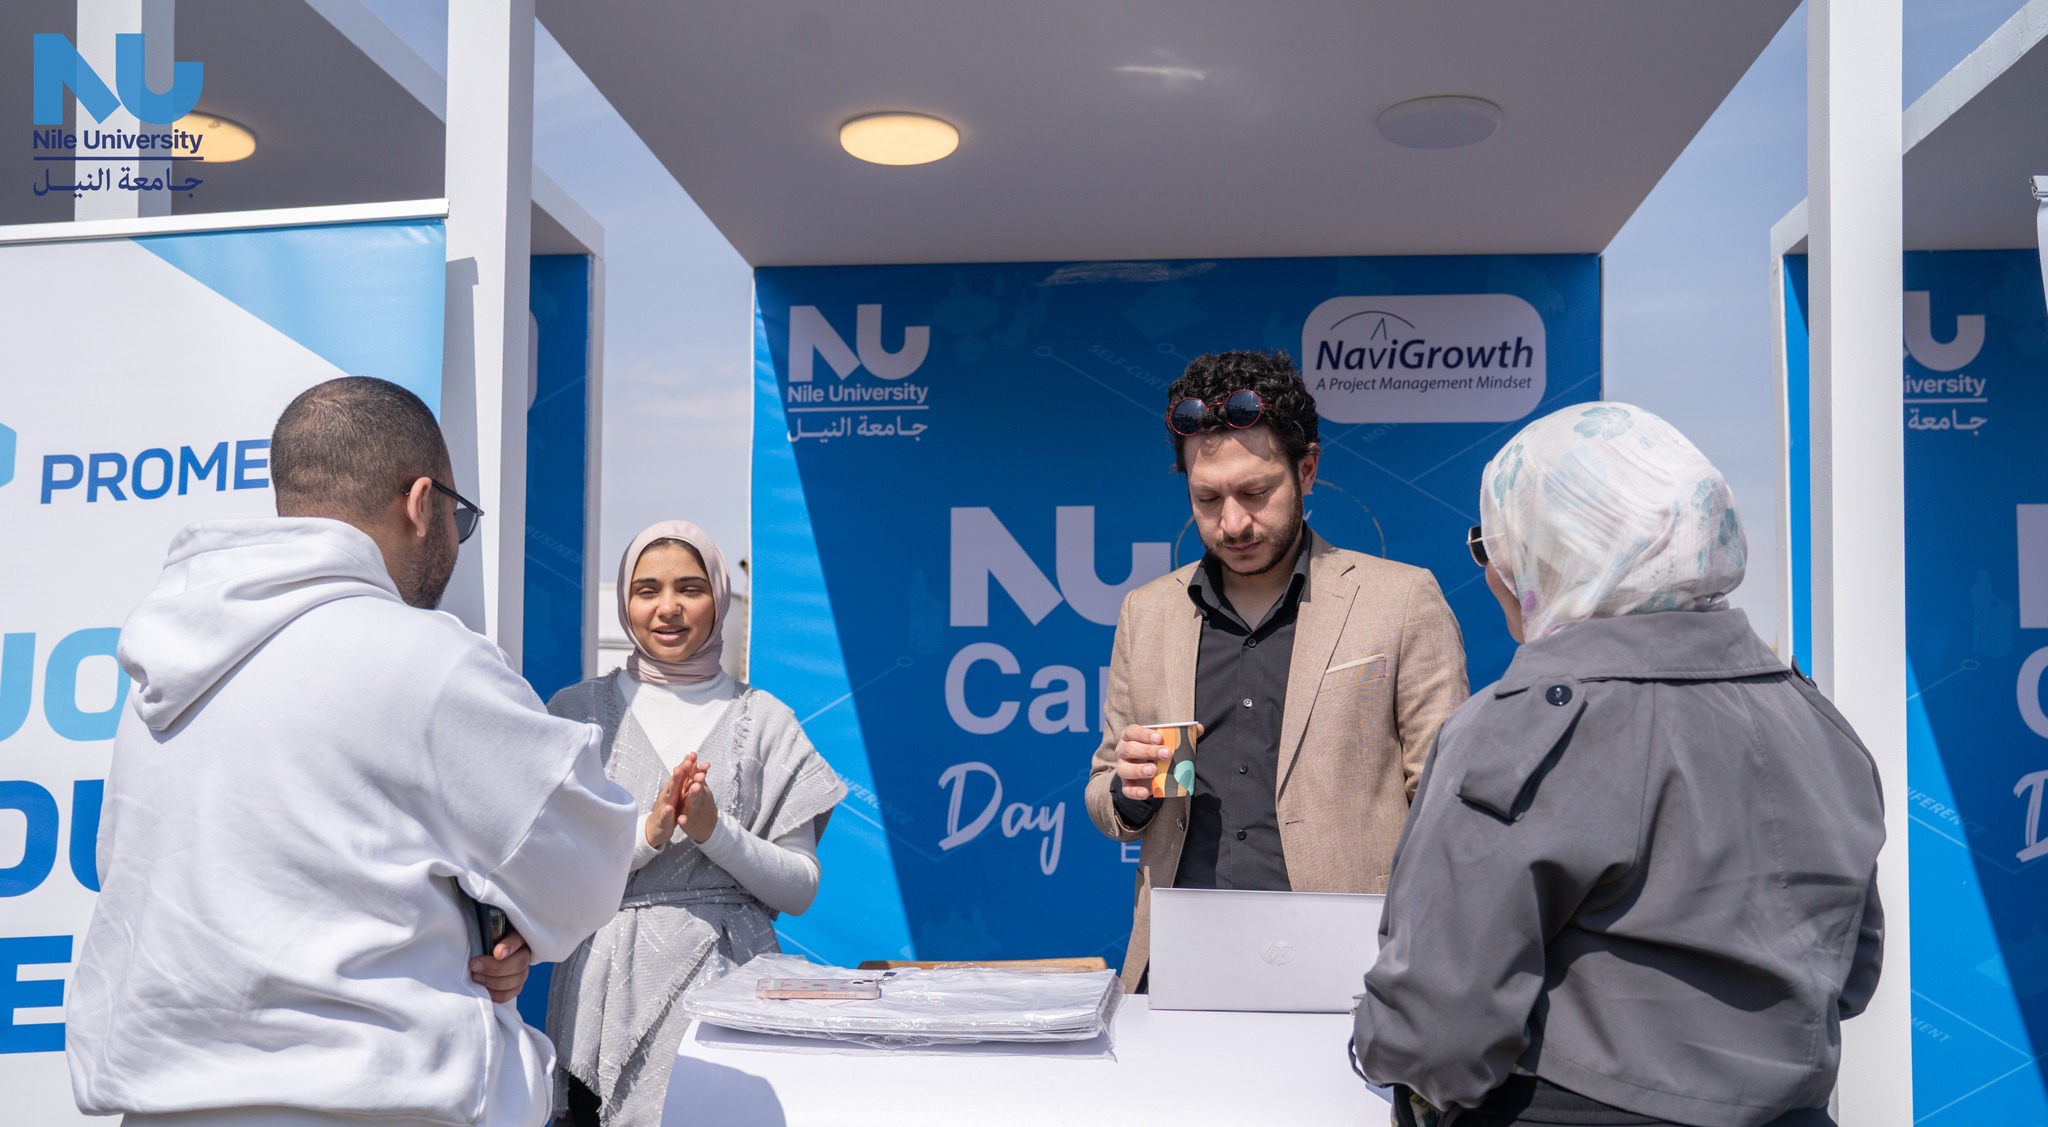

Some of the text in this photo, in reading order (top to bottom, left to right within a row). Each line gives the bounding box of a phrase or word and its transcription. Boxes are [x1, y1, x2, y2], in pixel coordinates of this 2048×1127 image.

[788, 303, 931, 382] NU
[1316, 336, 1533, 371] NaviGrowth
[1088, 344, 1170, 394] SELF-CONT
[1316, 376, 1532, 394] A Project Management Mindset
[1904, 374, 1986, 397] iversity
[787, 382, 929, 405] Nile University
[950, 505, 1172, 628] NU
[938, 761, 1066, 876] Day
